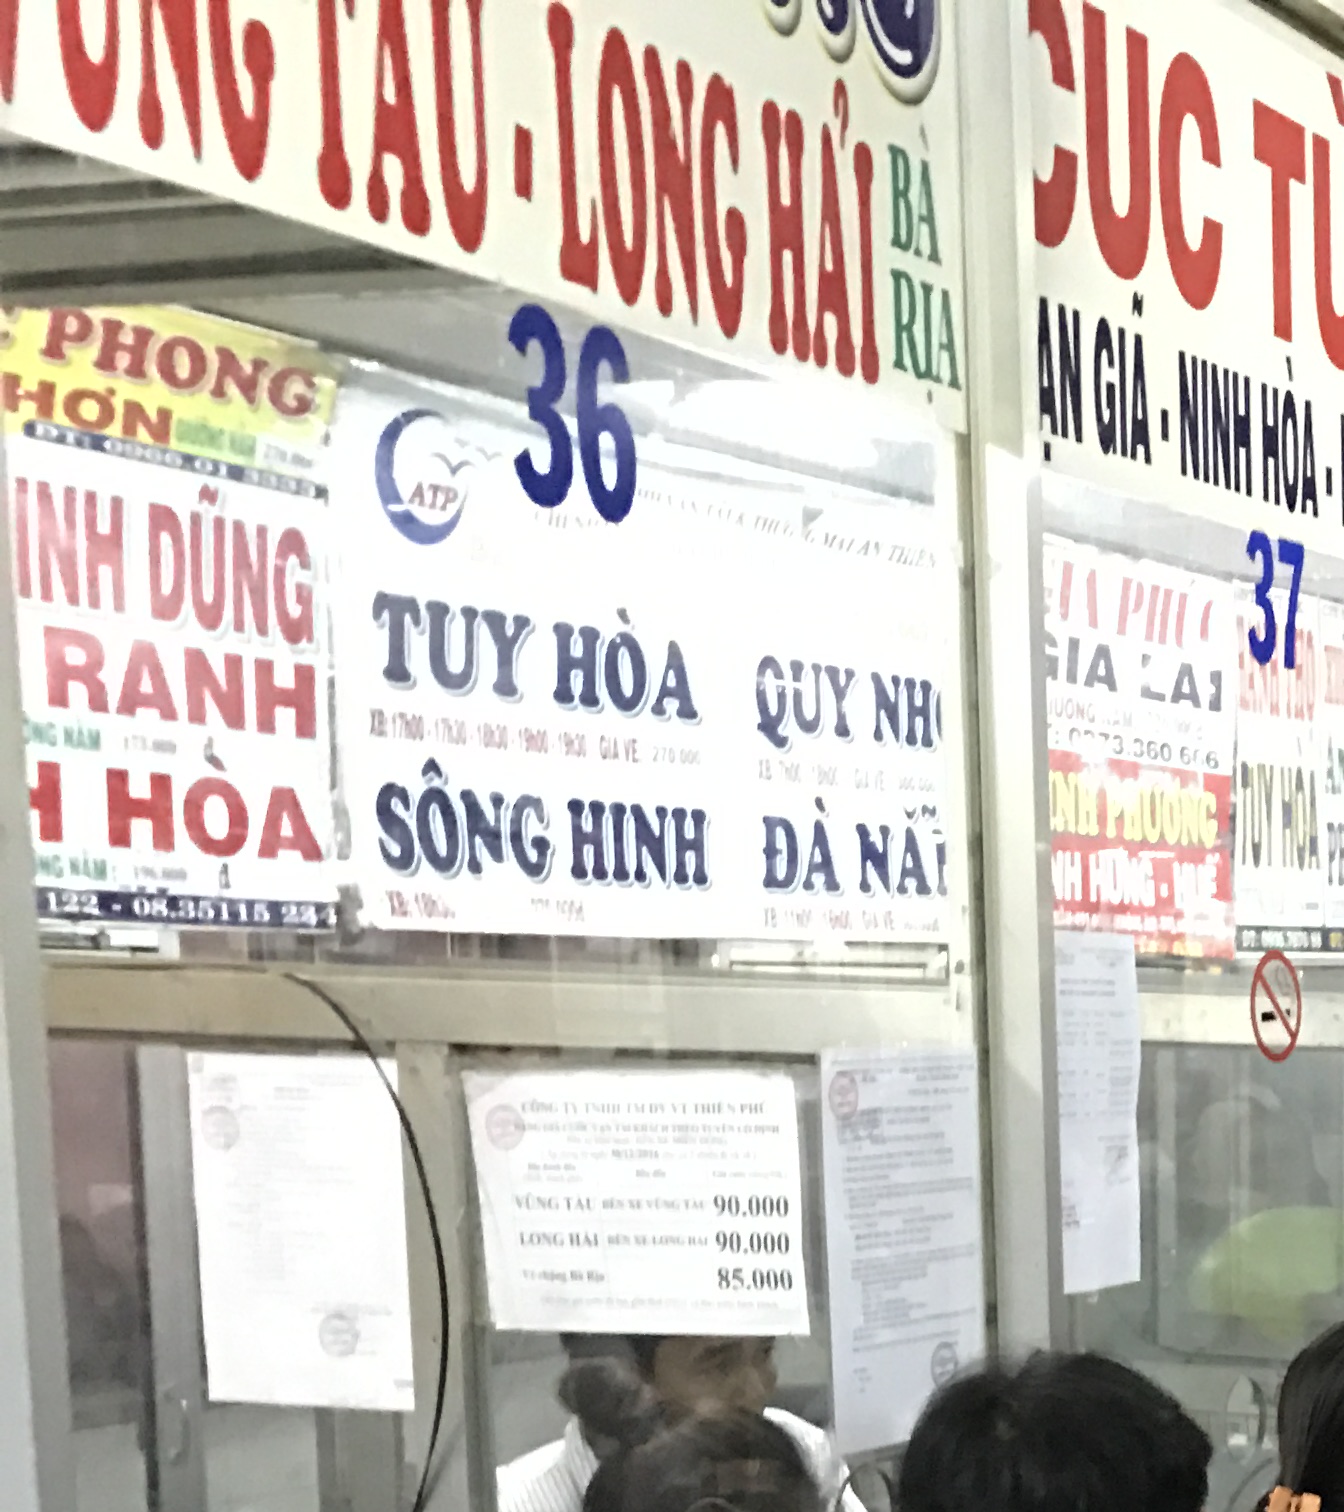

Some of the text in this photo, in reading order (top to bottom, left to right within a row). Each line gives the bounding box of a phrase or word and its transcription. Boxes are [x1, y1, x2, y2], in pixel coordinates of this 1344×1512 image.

[547, 1, 747, 338] LONG
[761, 78, 880, 385] HẢI
[888, 122, 942, 267] BÀ
[40, 306, 318, 419] PHONG
[890, 267, 962, 405] RỊA
[507, 303, 638, 523] 36
[1094, 291, 1152, 466] GIÃ
[1178, 349, 1252, 498] NINH
[1261, 355, 1319, 519] HÒA
[406, 481, 460, 513] ATP
[148, 482, 317, 647] DŨNG
[1246, 530, 1306, 670] 37
[43, 625, 317, 740] RANH
[372, 590, 700, 721] TUY HÒA
[755, 655, 856, 750] QUY
[105, 752, 325, 863] HÒA
[375, 756, 709, 886] SÔNG HINH
[762, 796, 843, 894] ĐÀ
[47, 892, 102, 916] 122
[712, 1193, 790, 1219] 90.000
[715, 1230, 791, 1255] 90.000
[717, 1267, 794, 1291] 85.000
